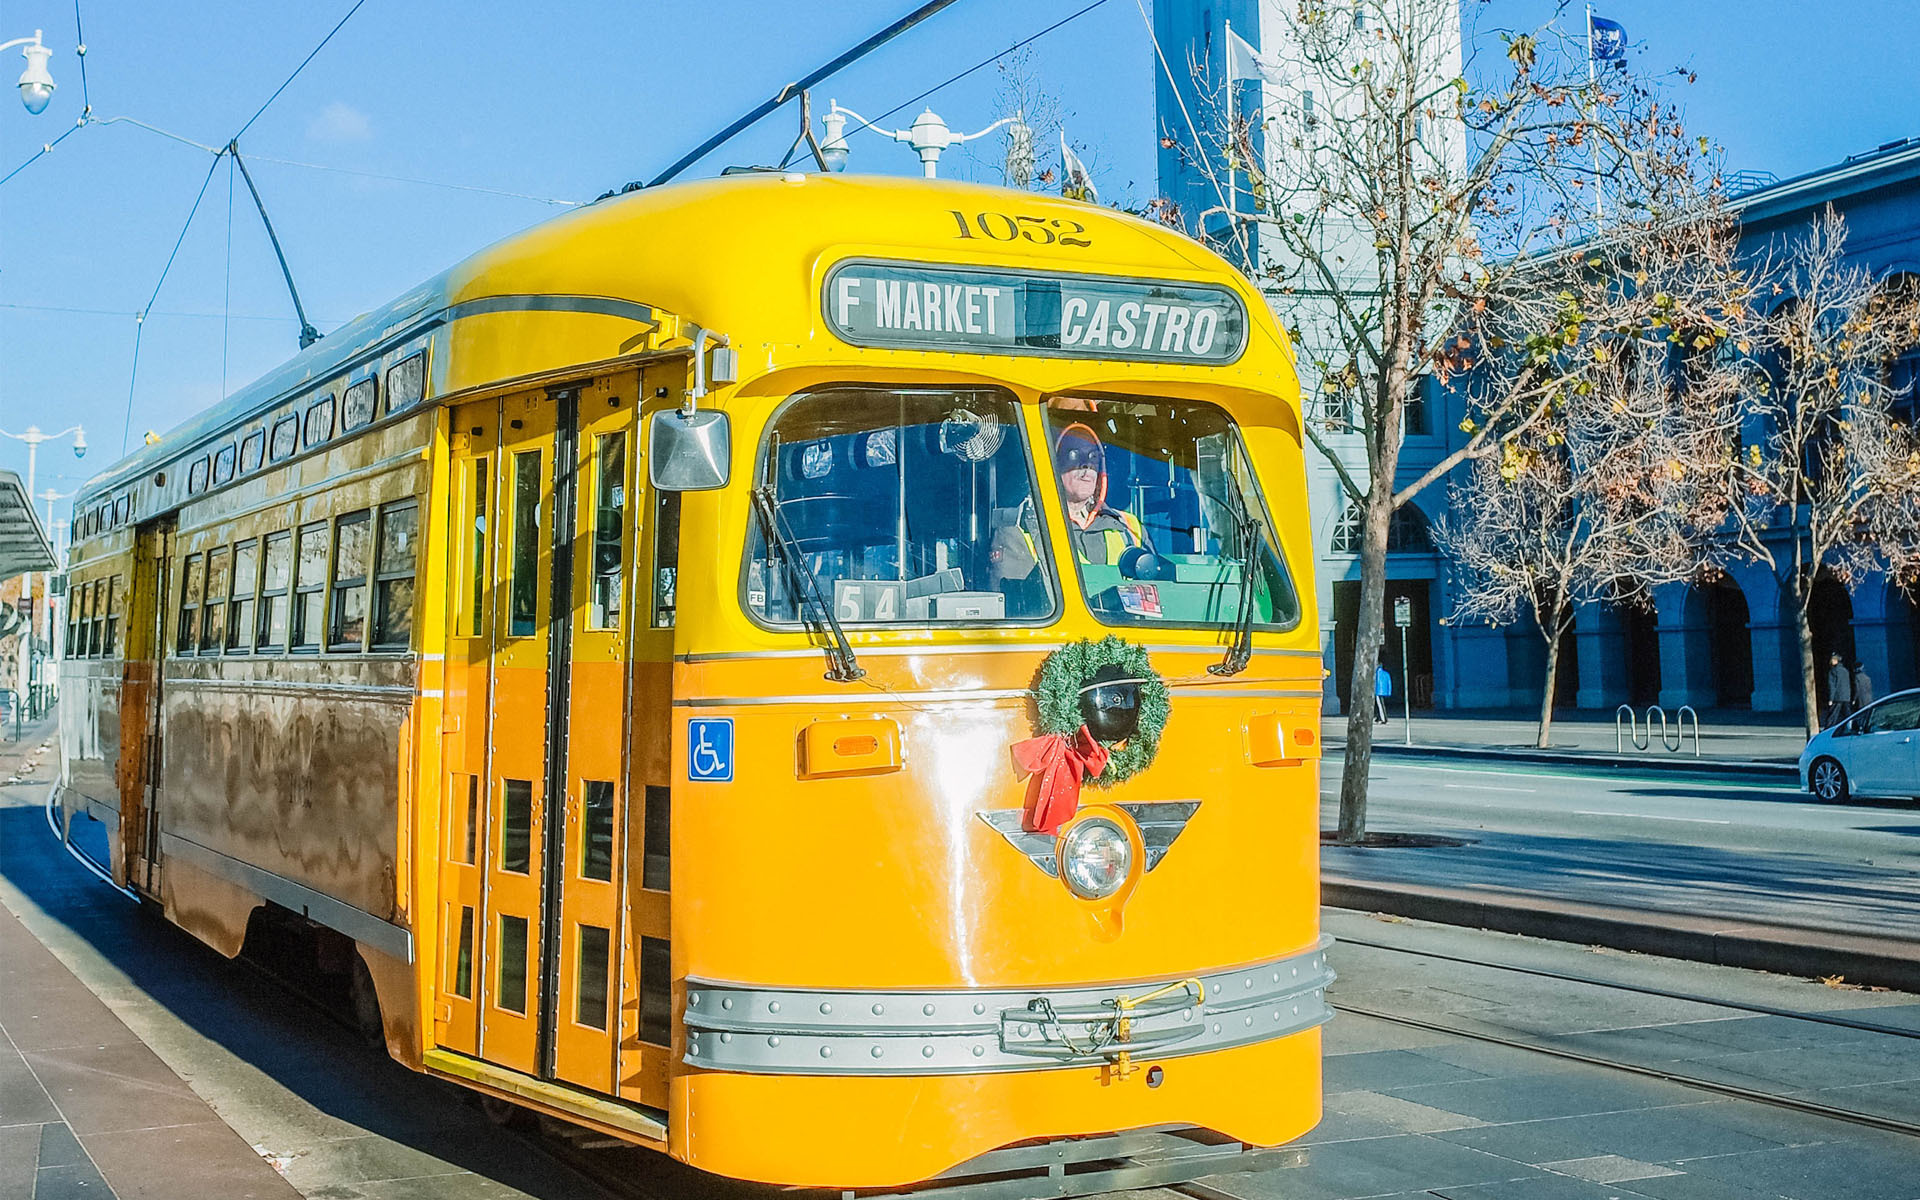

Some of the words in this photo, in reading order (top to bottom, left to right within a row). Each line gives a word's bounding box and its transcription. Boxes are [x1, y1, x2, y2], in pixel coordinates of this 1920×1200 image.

[944, 210, 1092, 247] 1052
[838, 277, 861, 326] F
[876, 279, 1000, 335] MARKET
[1060, 297, 1218, 355] CASTRO
[750, 593, 764, 602] FB
